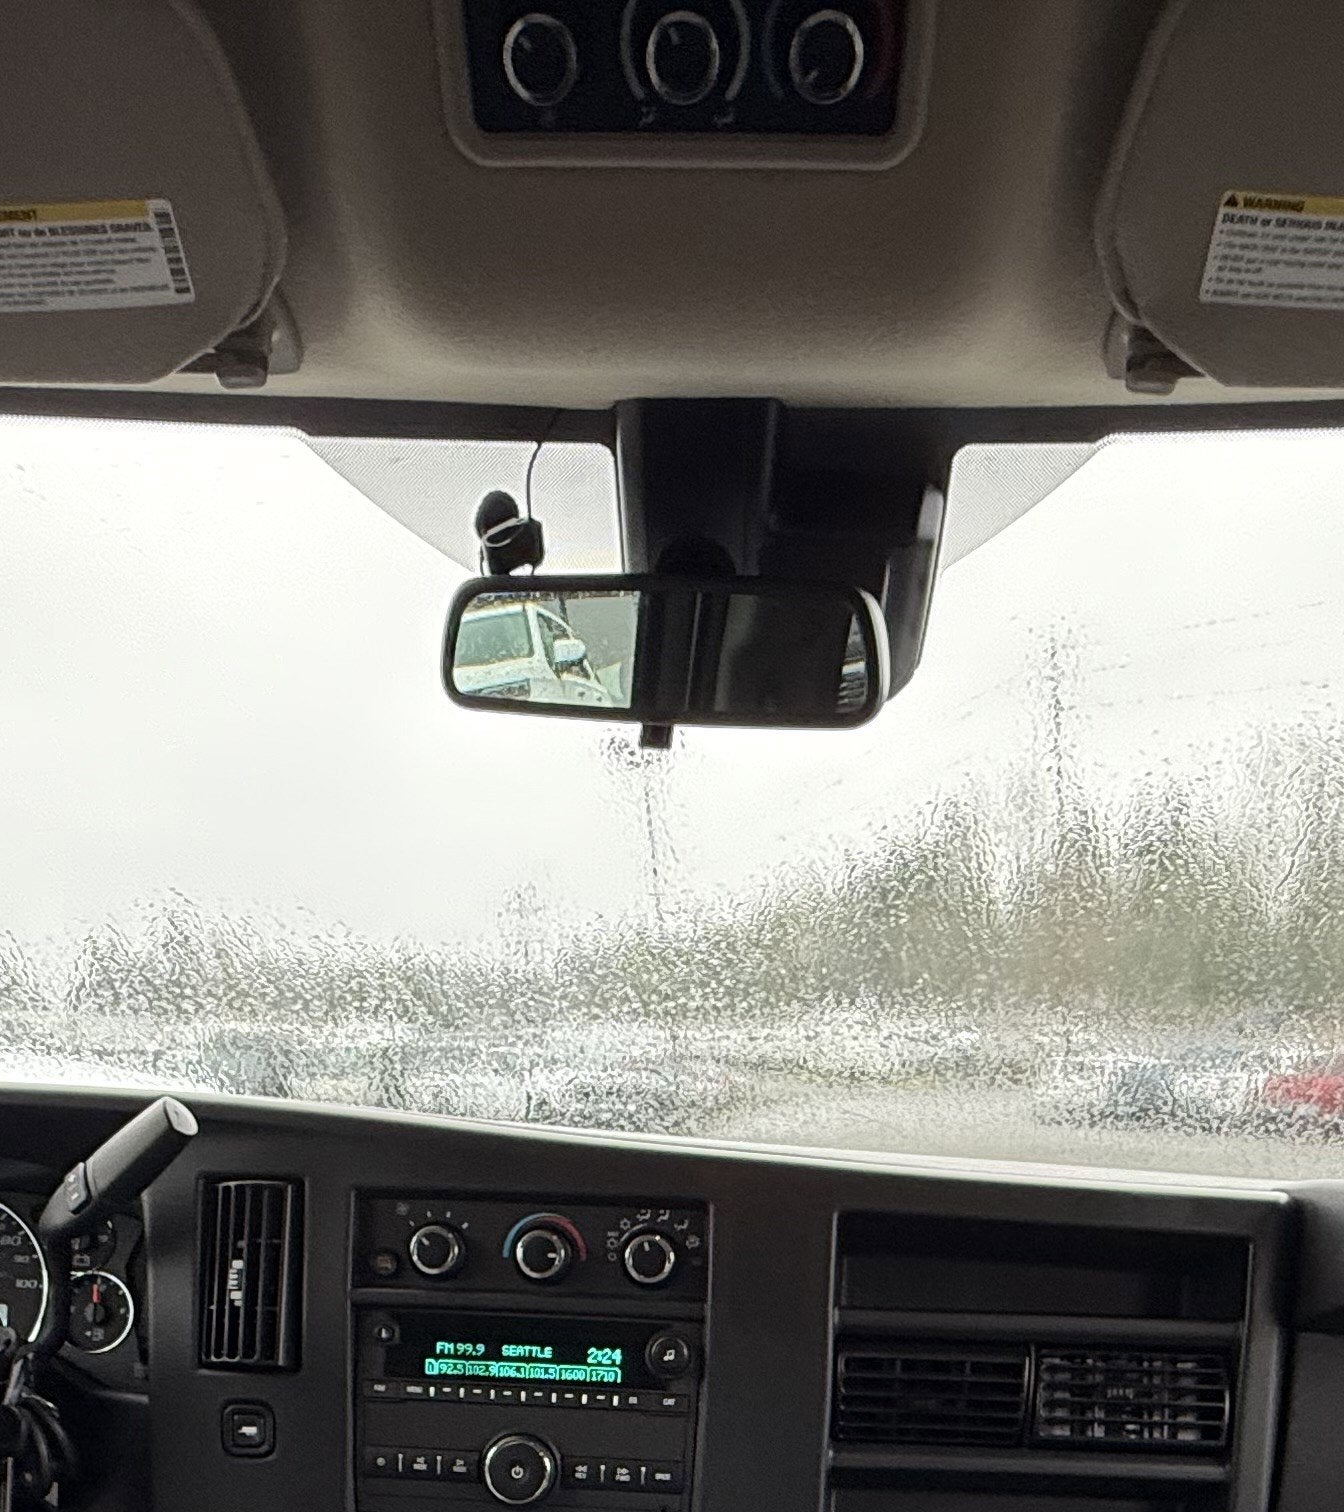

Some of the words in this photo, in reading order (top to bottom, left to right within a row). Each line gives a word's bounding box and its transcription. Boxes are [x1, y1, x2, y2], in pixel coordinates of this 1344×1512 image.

[1243, 196, 1305, 212] WARNING
[1221, 213, 1258, 225] DEATH
[436, 1341, 454, 1355] FM
[456, 1343, 485, 1356] 99.9
[502, 1345, 553, 1359] SEATTLE
[587, 1347, 622, 1365] 2:24
[439, 1363, 464, 1375] 92.5
[467, 1364, 496, 1377] 102.9
[498, 1365, 526, 1379] 106.1
[529, 1366, 556, 1379] 101.5
[561, 1368, 585, 1380] 1600
[591, 1369, 615, 1382] 1710
